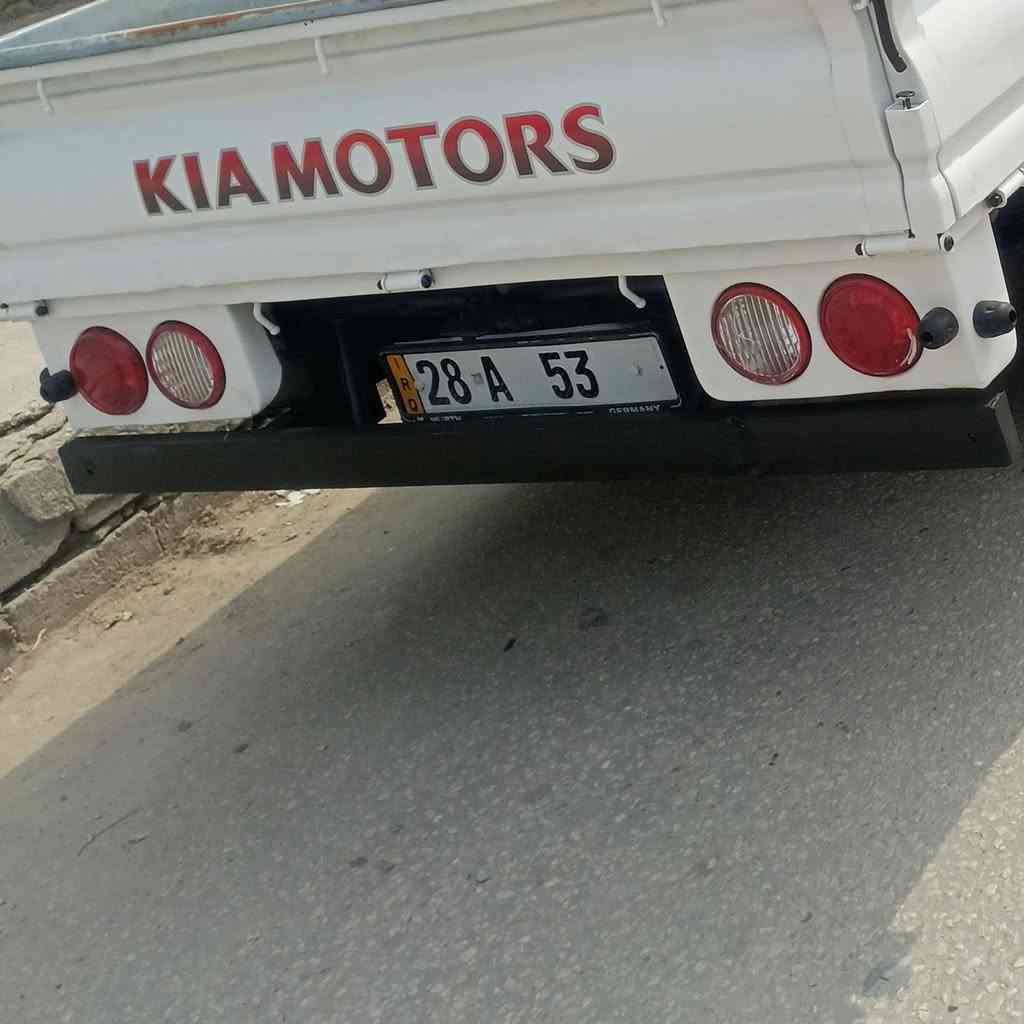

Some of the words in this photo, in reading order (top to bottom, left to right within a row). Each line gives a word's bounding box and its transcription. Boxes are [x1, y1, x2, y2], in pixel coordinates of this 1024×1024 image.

[133, 147, 268, 217] KIA
[270, 103, 616, 202] MOTORS
[415, 358, 472, 406] 28
[481, 355, 515, 402] A
[538, 349, 600, 400] 53
